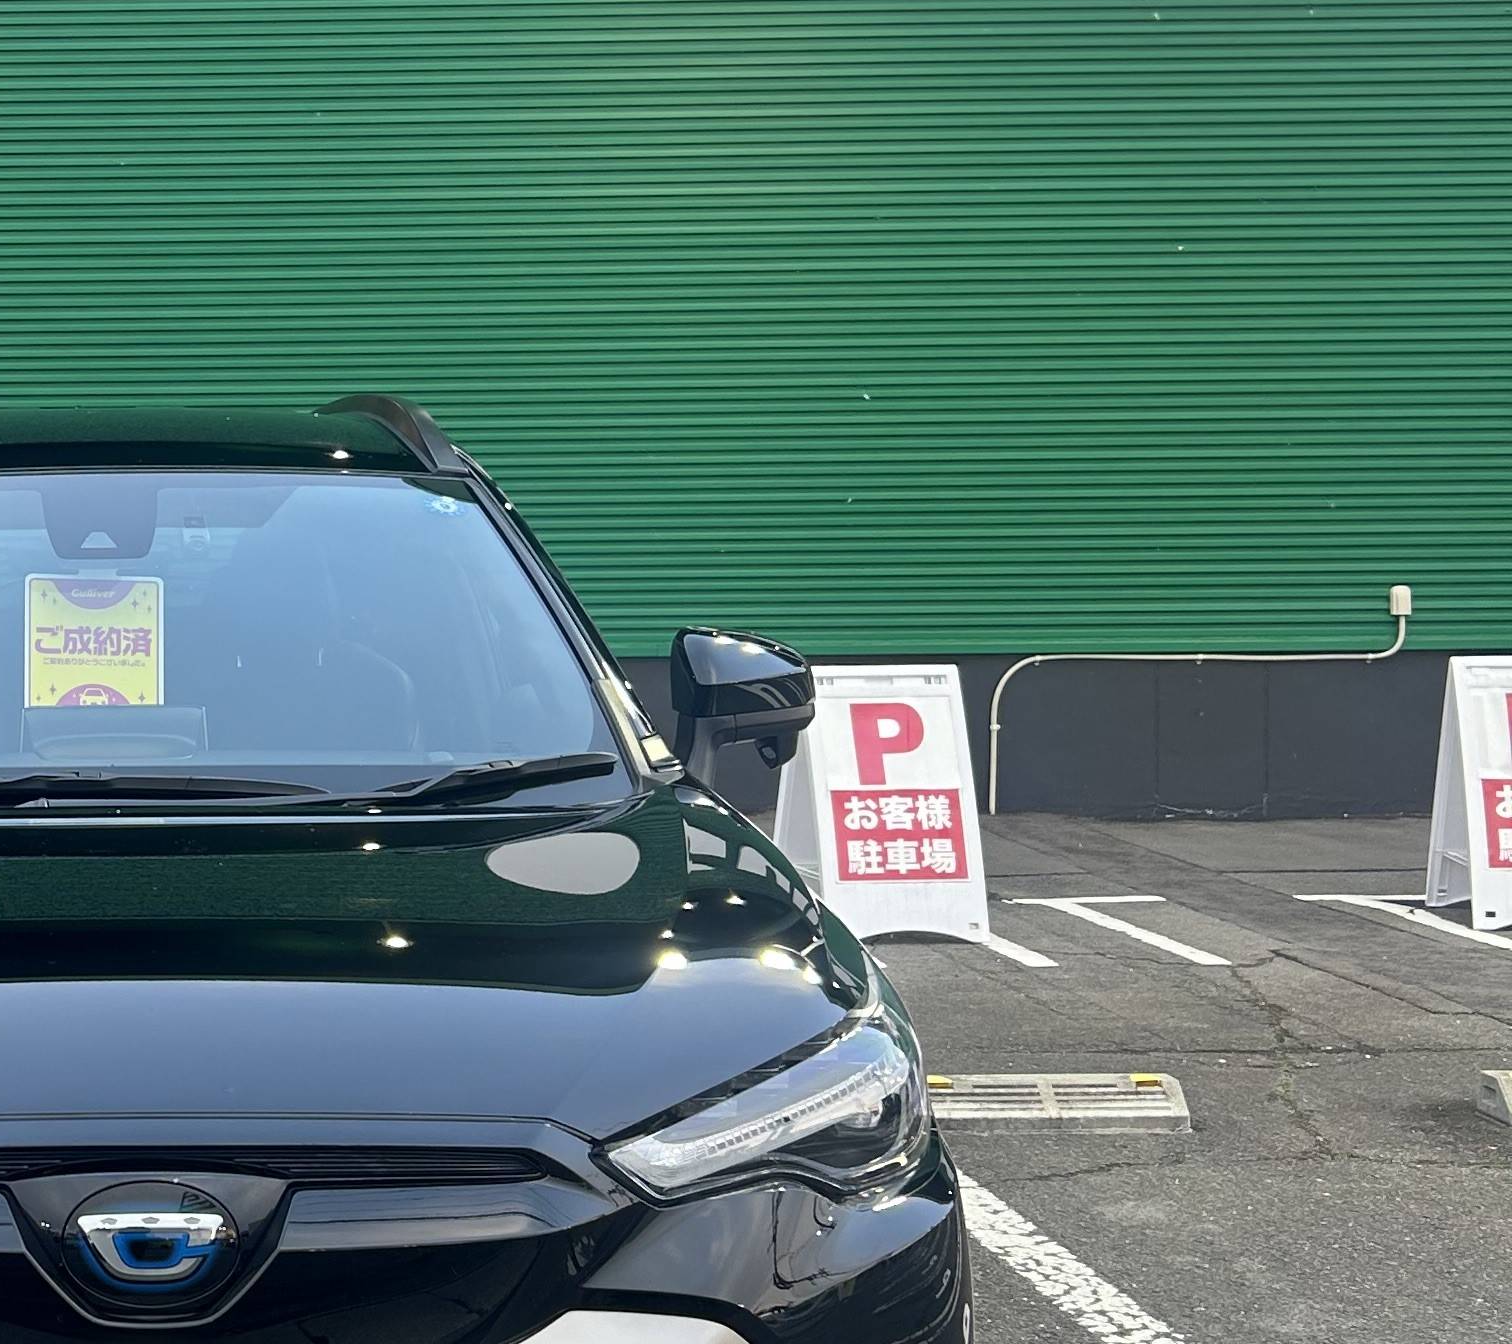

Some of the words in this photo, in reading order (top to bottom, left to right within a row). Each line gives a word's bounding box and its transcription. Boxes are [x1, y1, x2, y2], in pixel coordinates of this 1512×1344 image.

[34, 624, 152, 656] ご成約済
[849, 702, 924, 785] P
[843, 794, 952, 830] お客様
[846, 838, 957, 875] 駐車場
